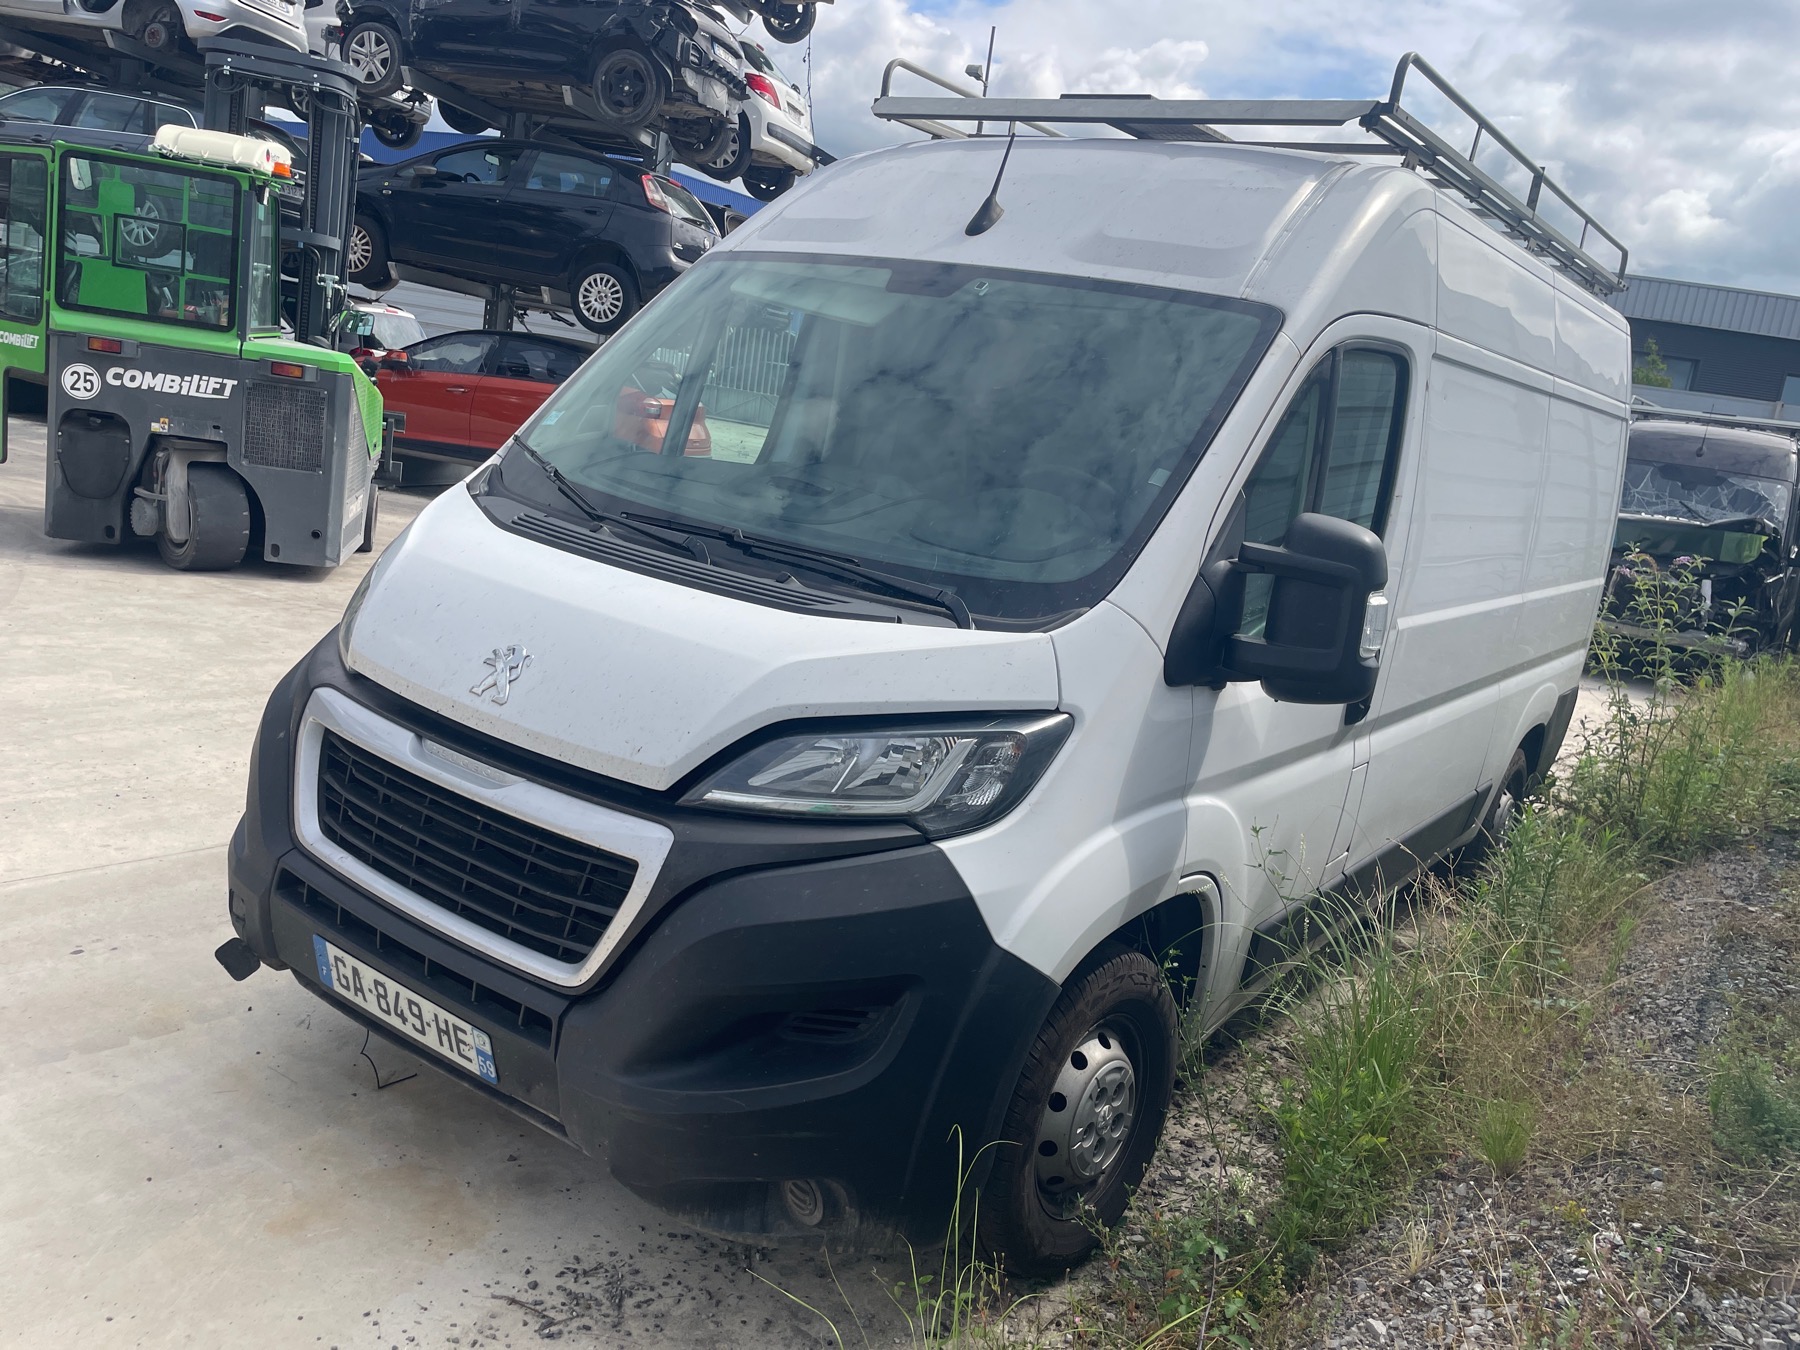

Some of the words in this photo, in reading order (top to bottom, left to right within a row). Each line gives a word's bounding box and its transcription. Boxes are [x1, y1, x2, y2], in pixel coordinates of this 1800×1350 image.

[69, 370, 95, 393] 25
[334, 954, 473, 1064] GA-849-HE
[478, 1055, 496, 1078] 59
